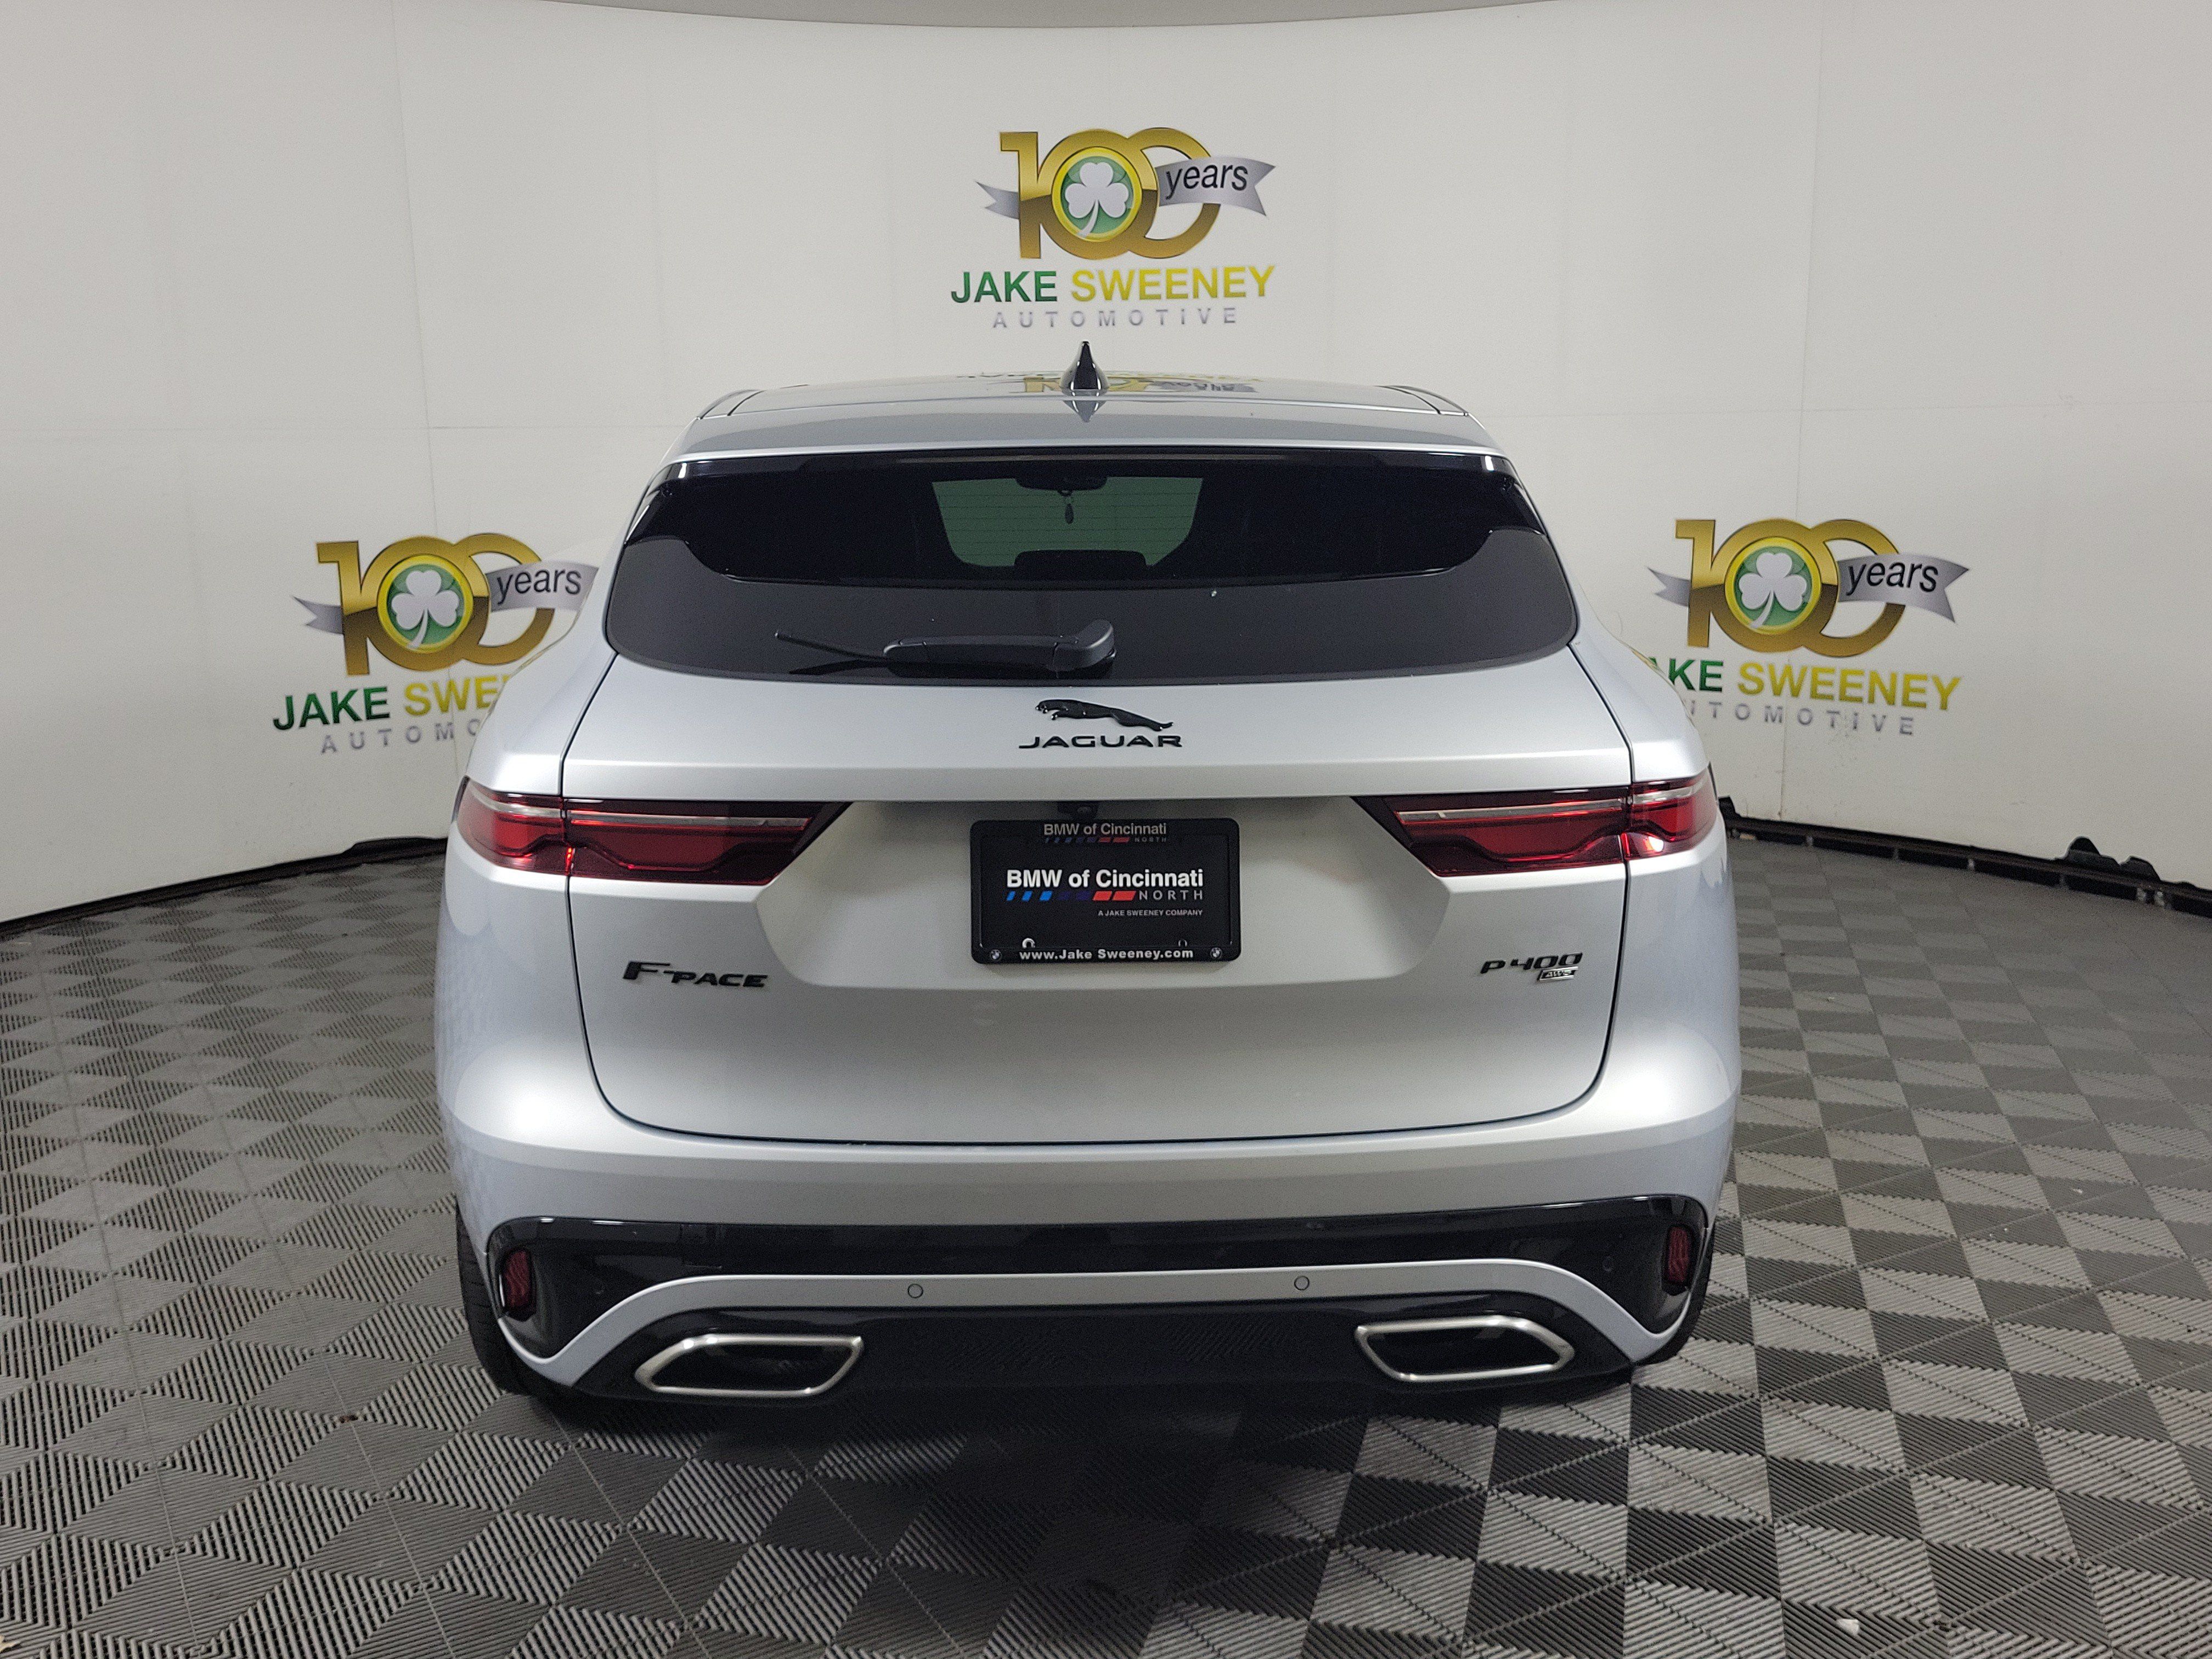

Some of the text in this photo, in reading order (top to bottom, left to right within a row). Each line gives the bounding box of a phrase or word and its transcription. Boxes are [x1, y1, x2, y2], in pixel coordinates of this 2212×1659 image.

[999, 127, 1221, 259] 100
[1166, 164, 1248, 200] years
[951, 266, 1276, 303] JAKE SWEENEY
[992, 308, 1236, 328] AUTOMOTIVE
[496, 566, 582, 604] years
[1675, 518, 1906, 658] 100
[1846, 561, 1938, 596] years
[315, 533, 555, 675] 100
[1648, 657, 1962, 711] KE SWEENEY
[273, 674, 509, 730] JAKE SWE
[1018, 735, 1183, 749] JAGUAR
[1043, 822, 1167, 836] BMW of Cincinnati
[1007, 868, 1203, 888] BMW of Cincinnati
[1139, 890, 1203, 900] NORTH
[1019, 948, 1193, 960] www.Jake Sweeney.com
[1480, 952, 1583, 974] P400
[623, 962, 768, 988] F-PACE
